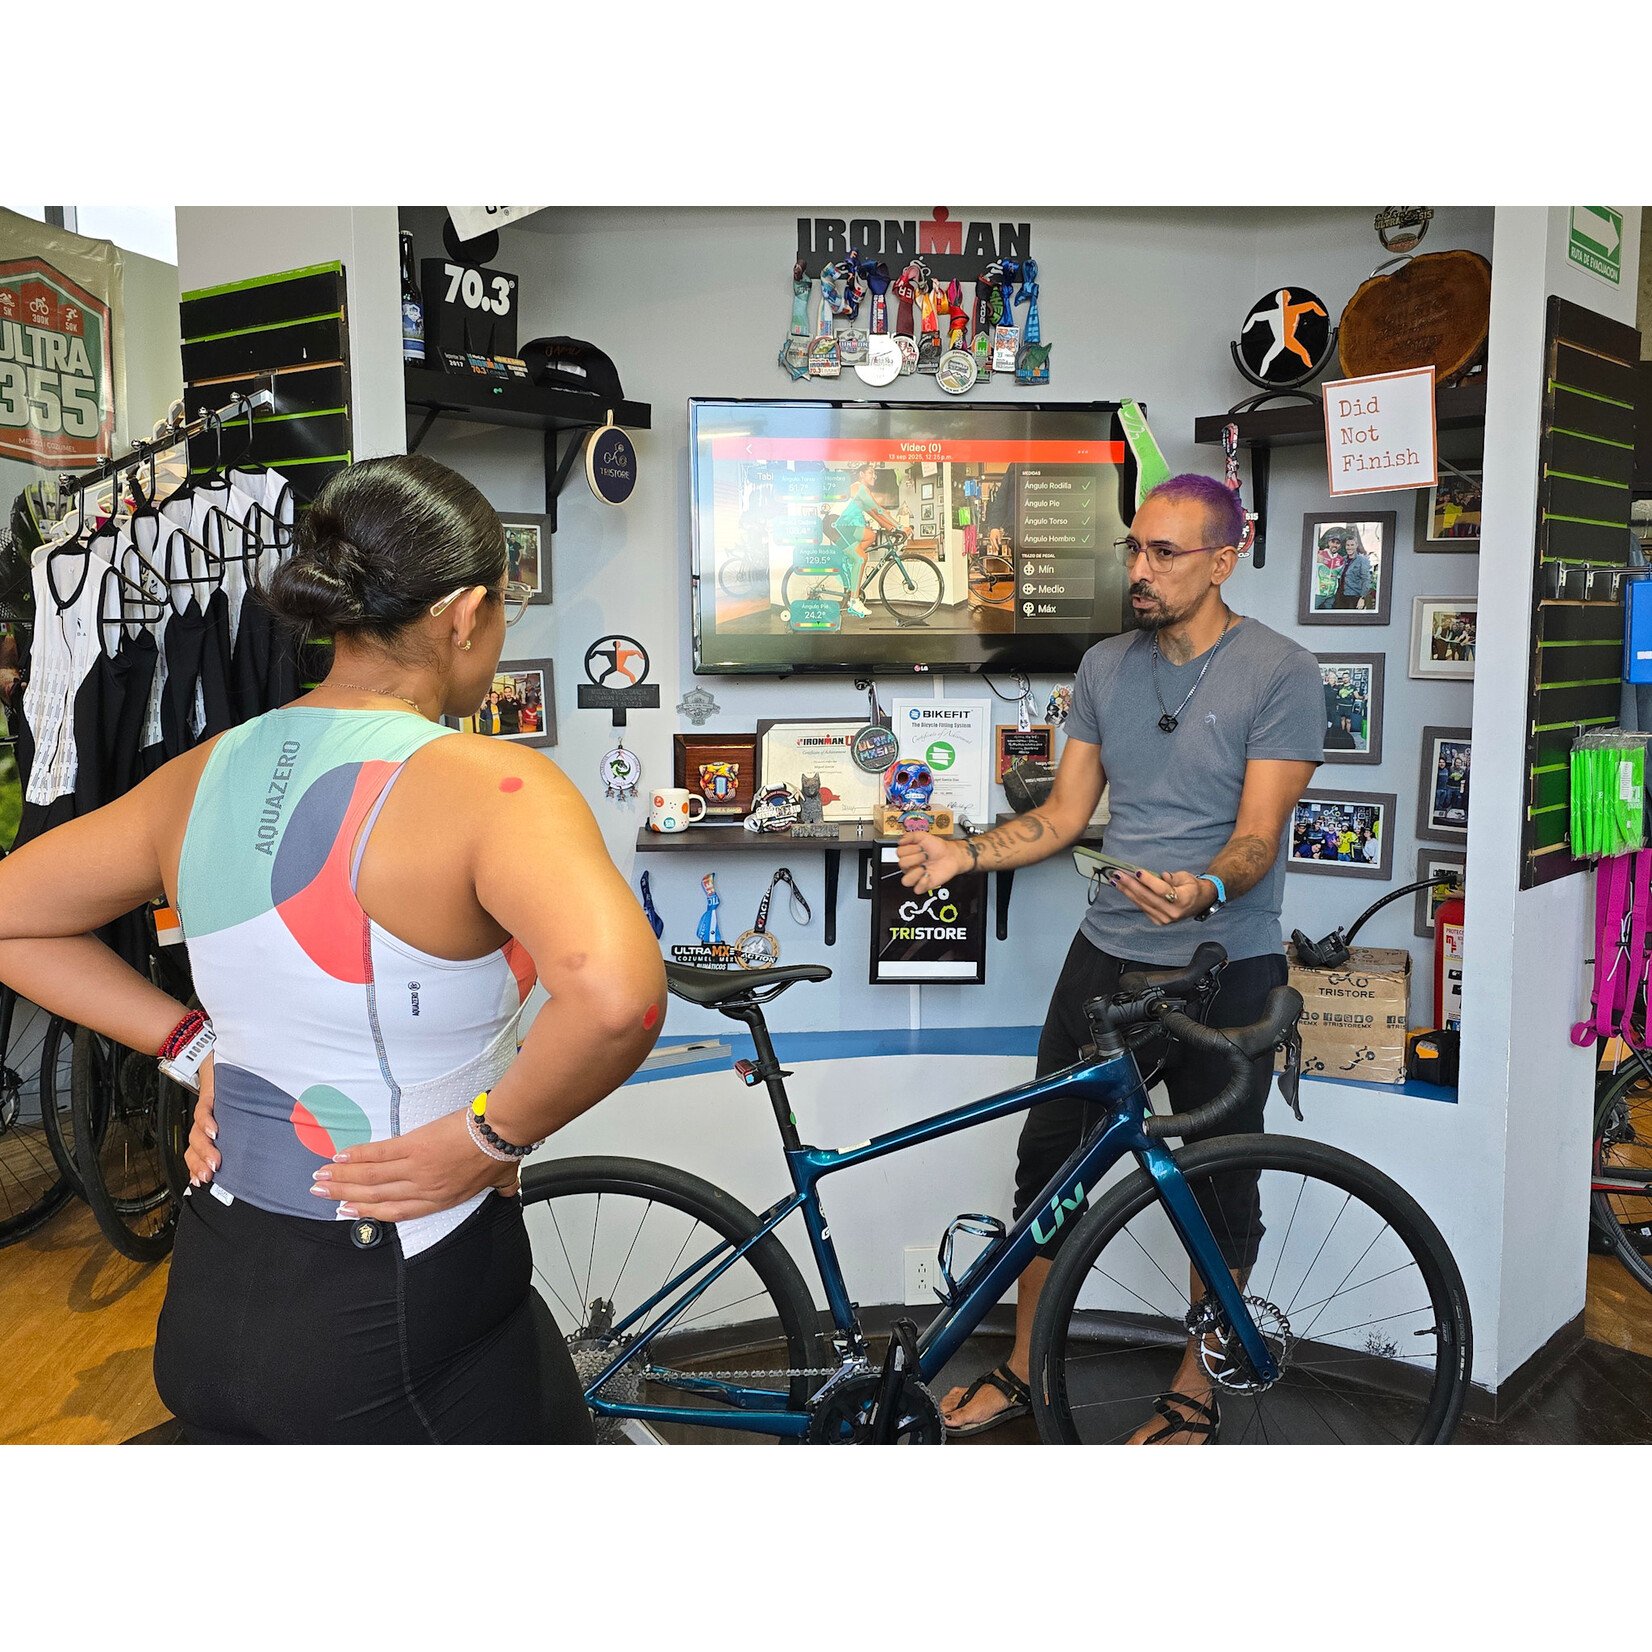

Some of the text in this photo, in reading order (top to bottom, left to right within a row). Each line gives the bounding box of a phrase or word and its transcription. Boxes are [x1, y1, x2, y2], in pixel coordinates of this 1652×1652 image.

[797, 206, 1031, 257] IRONMAN
[1584, 253, 1590, 266] DE
[0, 320, 94, 377] ULTRA
[0, 361, 100, 438] 355
[1339, 396, 1380, 418] Did
[1341, 425, 1380, 445] Not
[900, 442, 942, 454] Video (0)
[1343, 449, 1420, 472] Finish
[1024, 481, 1072, 490] Ángulo Rodilla
[1024, 499, 1060, 508] Ángulo Pie
[1024, 516, 1068, 525] Ángulo Torso
[1024, 534, 1048, 543] Ángulo
[805, 556, 831, 564] 129.5°
[1038, 564, 1055, 574] Mín
[1038, 584, 1065, 594] Medio
[1038, 603, 1057, 613] Máx
[804, 611, 827, 619] 24.2°
[922, 710, 971, 719] BIKEFIT
[803, 734, 844, 746] IRONMAN
[254, 740, 301, 856] AQUAZERO
[889, 927, 967, 940] TRISTORE
[741, 952, 776, 964] ACTION
[1318, 987, 1375, 999] TRISTORE
[1030, 1181, 1085, 1245] Liv
